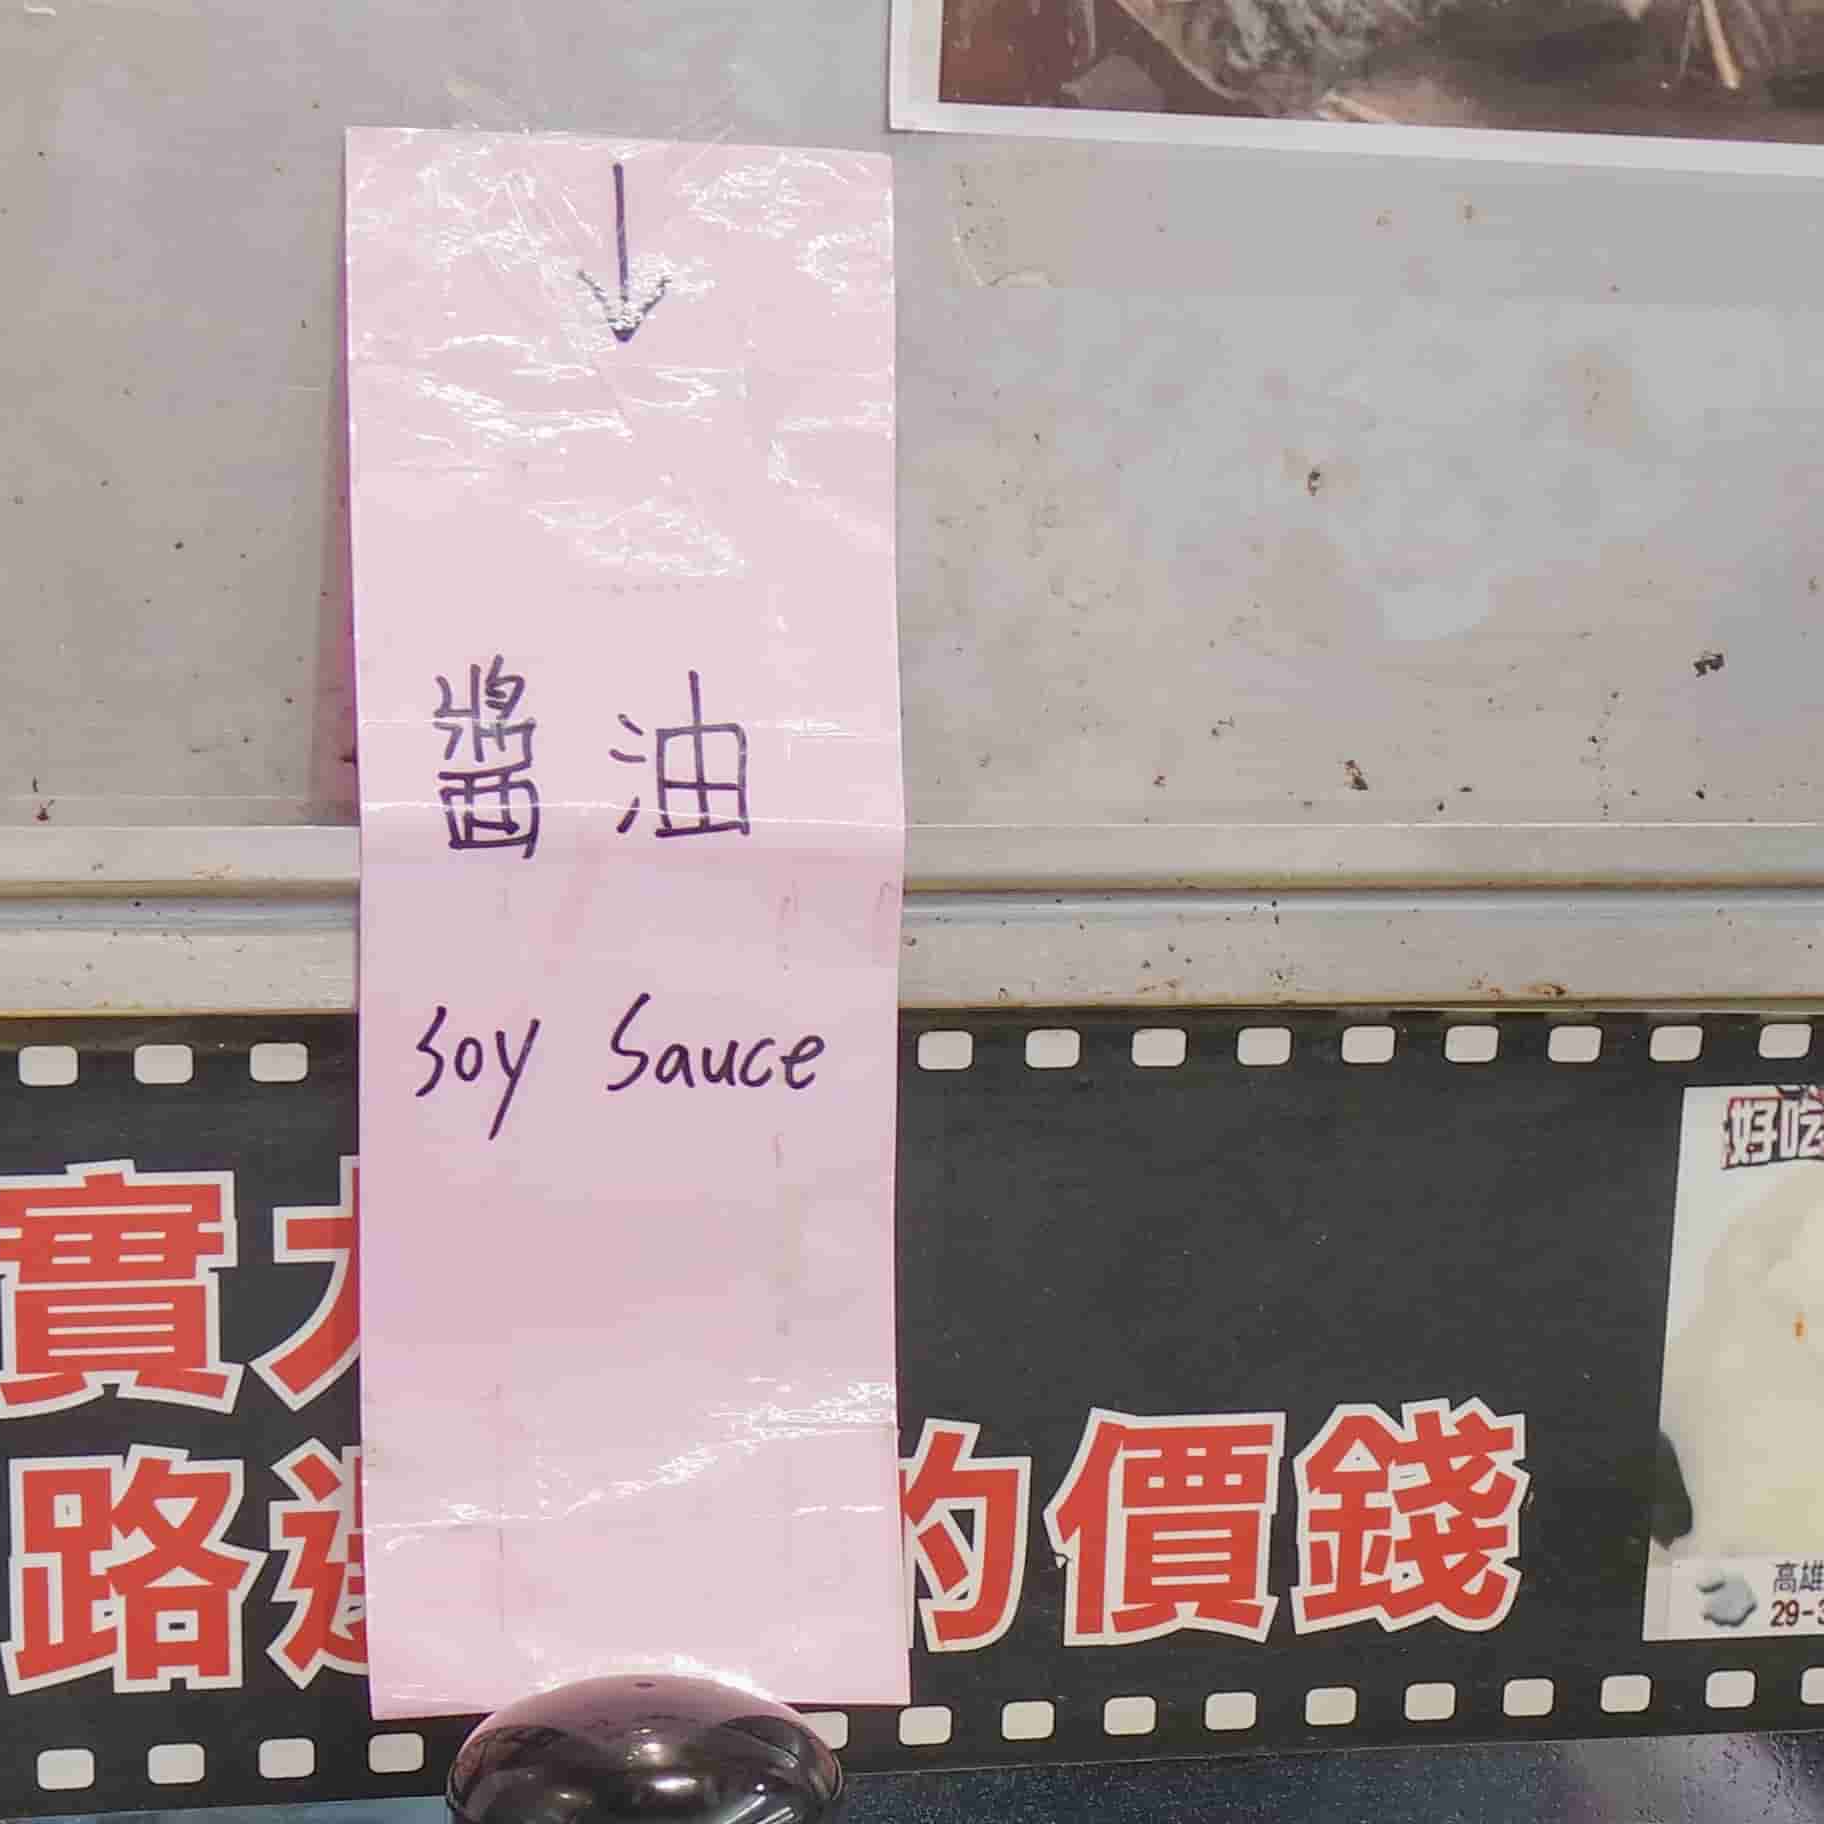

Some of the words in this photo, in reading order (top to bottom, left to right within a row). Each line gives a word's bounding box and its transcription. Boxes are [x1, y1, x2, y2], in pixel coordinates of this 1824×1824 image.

[432, 654, 751, 859] 醬油
[415, 1005, 541, 1140] Soy
[606, 992, 825, 1092] Sauce
